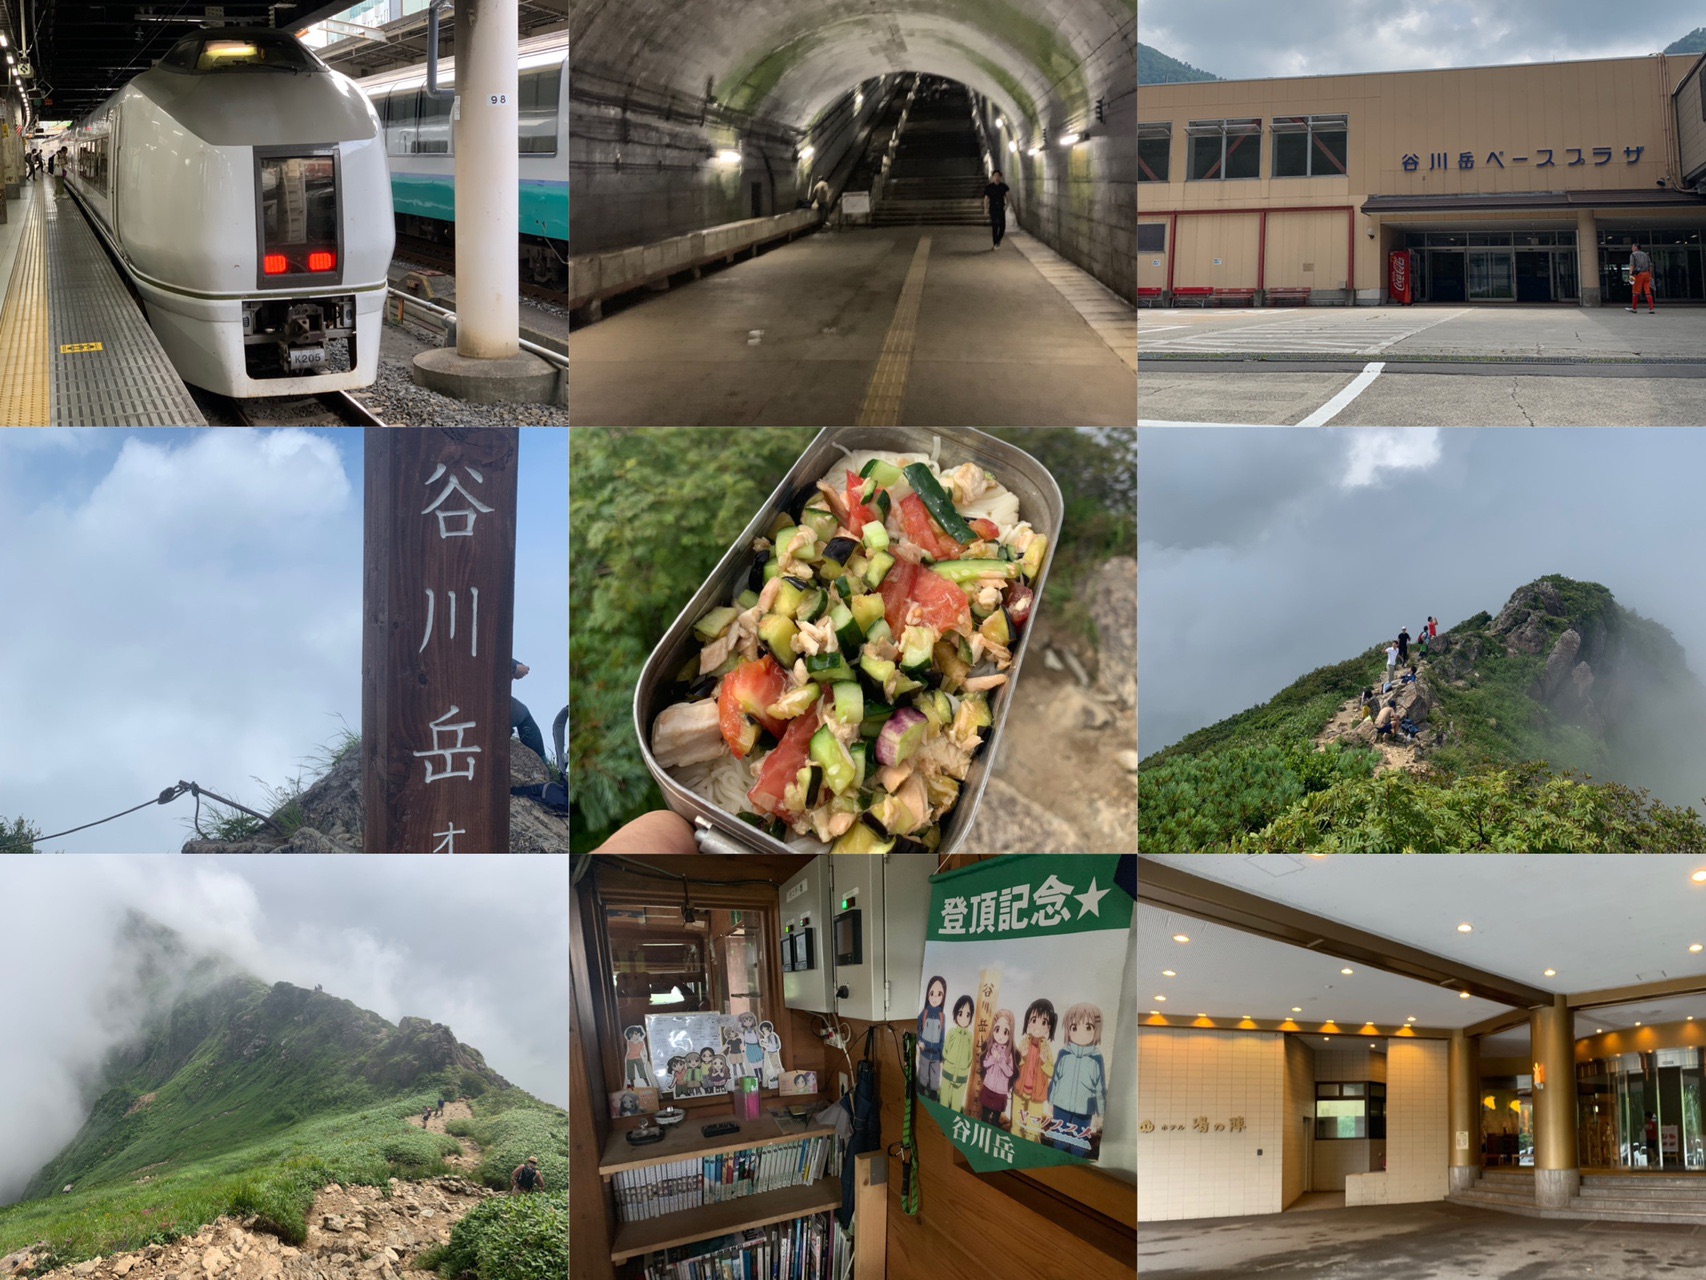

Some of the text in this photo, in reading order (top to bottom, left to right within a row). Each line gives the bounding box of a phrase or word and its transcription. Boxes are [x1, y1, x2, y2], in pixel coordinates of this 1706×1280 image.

[490, 95, 507, 105] 98
[1401, 146, 1645, 172] 谷川岳ベースプラザ
[294, 353, 322, 364] K205
[952, 1115, 1016, 1164] 谷川岳
